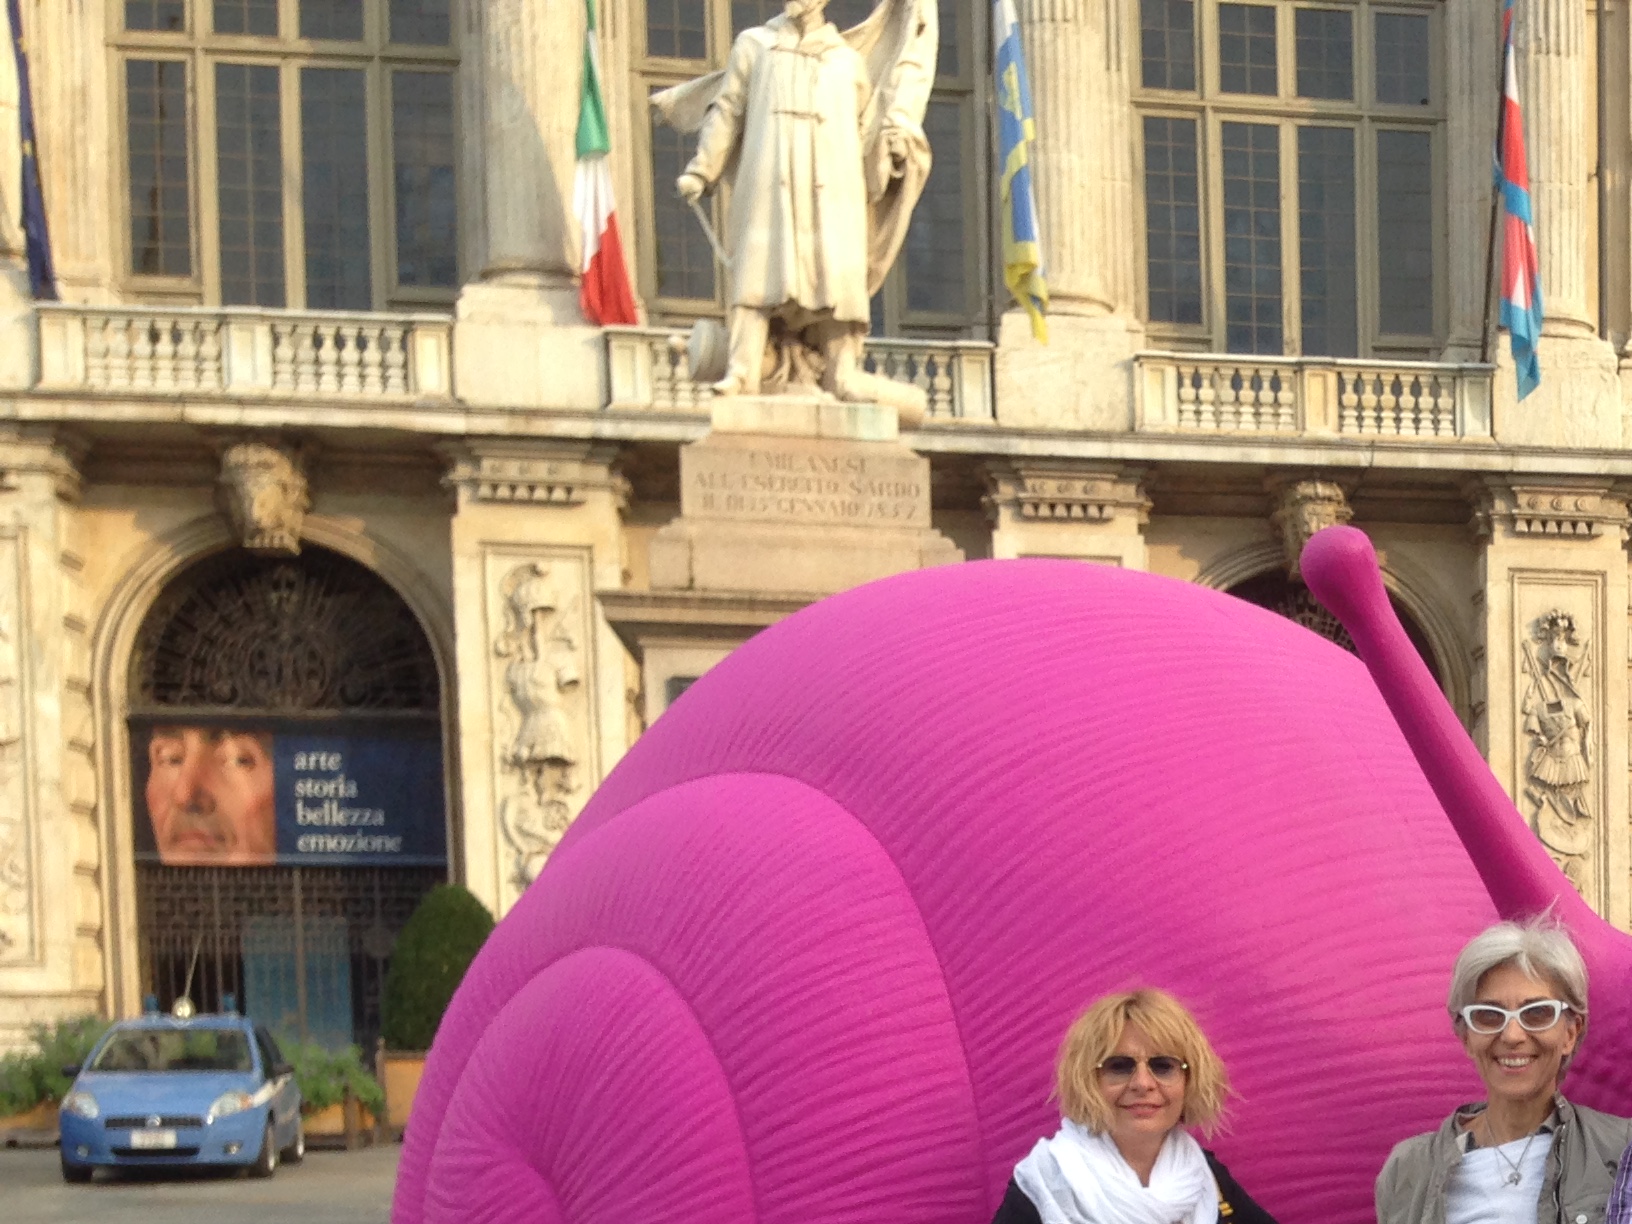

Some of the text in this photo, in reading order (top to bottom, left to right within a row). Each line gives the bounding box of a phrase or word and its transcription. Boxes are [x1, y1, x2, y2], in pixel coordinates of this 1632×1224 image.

[848, 480, 920, 499] SARDO
[294, 751, 342, 771] arte
[295, 773, 358, 799] storia
[297, 799, 385, 827] bellezza
[297, 828, 402, 853] emozione
